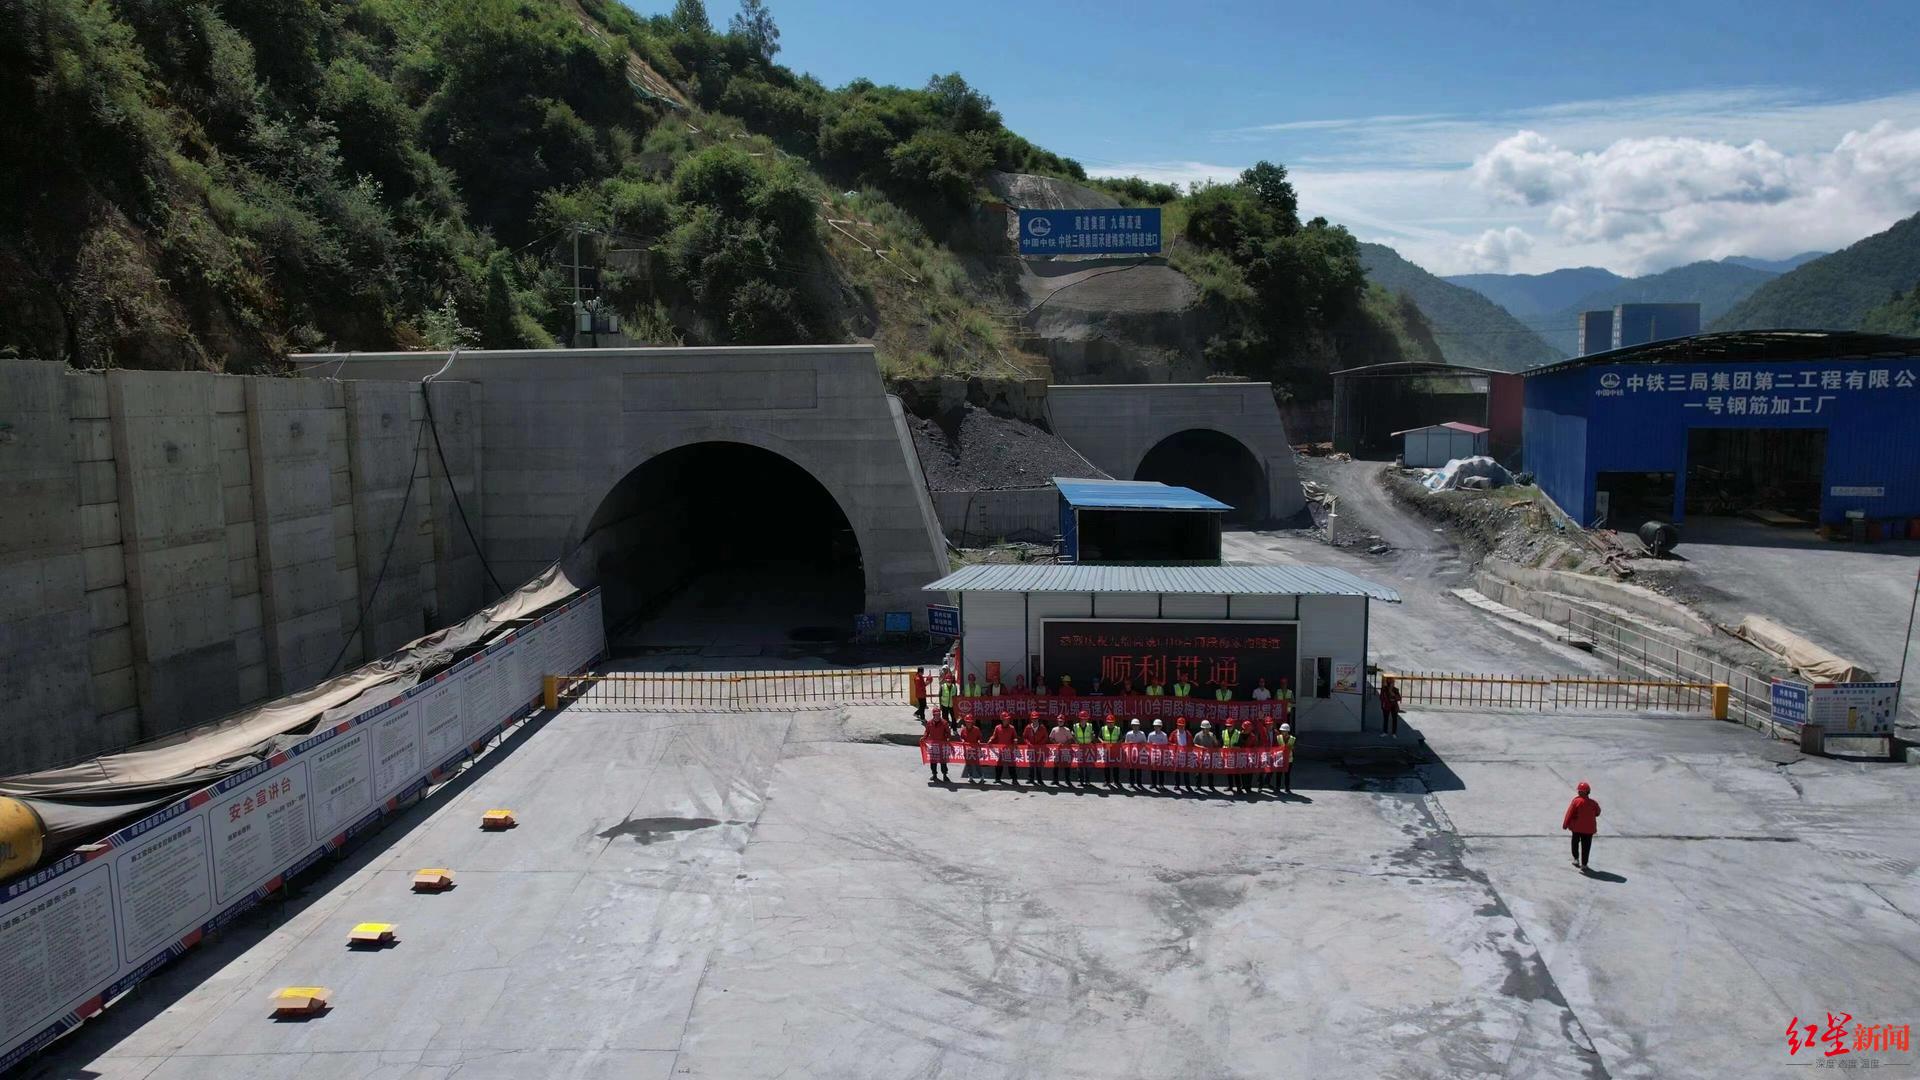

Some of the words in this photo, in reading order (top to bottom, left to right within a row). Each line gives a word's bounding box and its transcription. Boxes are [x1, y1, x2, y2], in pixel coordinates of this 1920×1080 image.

[1023, 239, 1057, 248] 中国中铁
[1626, 369, 1917, 393] 中铁三局集团第二工程有限公
[1595, 389, 1625, 397] 中国中铁
[1684, 396, 1837, 415] 一号钢筋加工厂
[1102, 654, 1241, 687] 顺利贯通
[229, 777, 291, 823] 安全宣讲台
